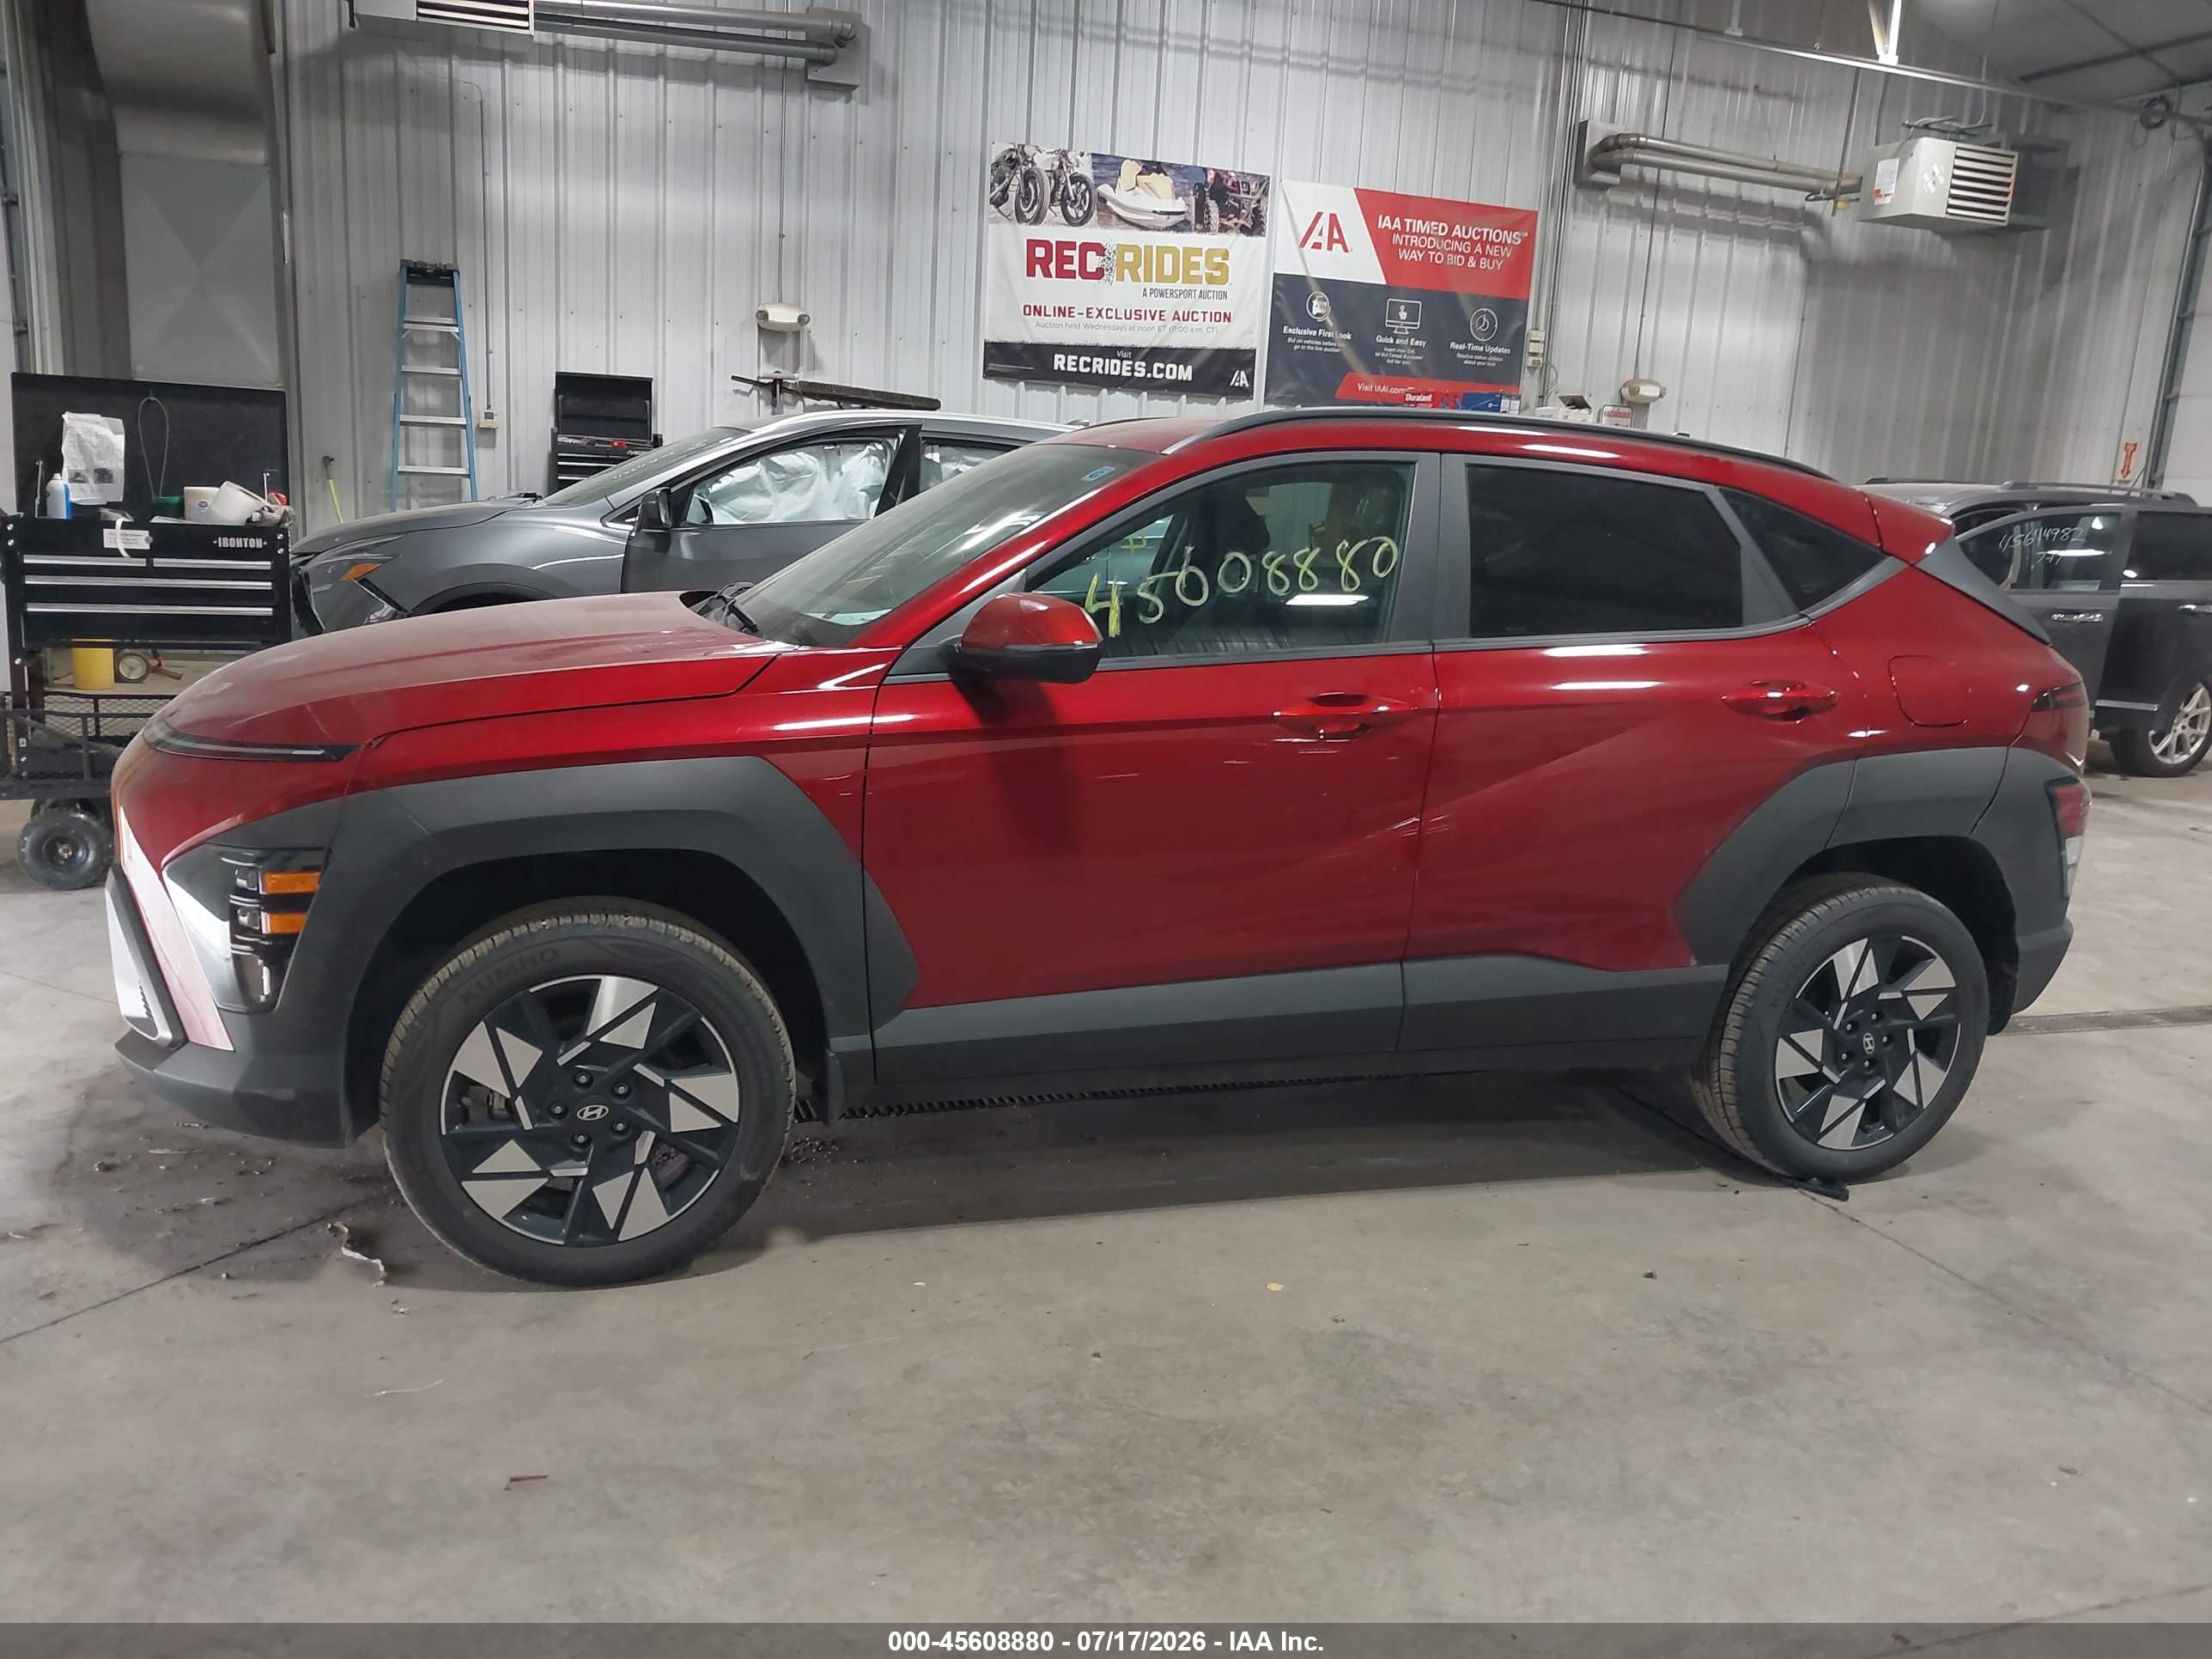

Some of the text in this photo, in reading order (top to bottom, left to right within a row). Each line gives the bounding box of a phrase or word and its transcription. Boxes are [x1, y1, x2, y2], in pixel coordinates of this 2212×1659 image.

[1377, 214, 1401, 231] IAA
[1404, 218, 1449, 236] TIMED
[1392, 233, 1512, 258] INTRODUCING A NEW
[1026, 239, 1230, 285] REC RIDES
[1398, 248, 1504, 270] WAY TO BID & BUY
[1142, 288, 1228, 301] A POWERSPORT AUCTION
[1023, 304, 1232, 324] ONLINE-EXCLUSIVE AUCTION
[1035, 321, 1064, 330] Auction
[1083, 323, 1127, 332] Wednesdays
[1283, 325, 1352, 340] Exclusive First Look
[1376, 334, 1395, 343] Quick
[1410, 337, 1426, 349] Easy
[1449, 341, 1511, 355] Real-Time Updates
[1116, 349, 1132, 359] Visit
[1053, 353, 1193, 381] RECRIDES.COM
[1357, 382, 1374, 393] Visit
[218, 537, 263, 549] IRONTON
[1085, 536, 1398, 637] 45608880
